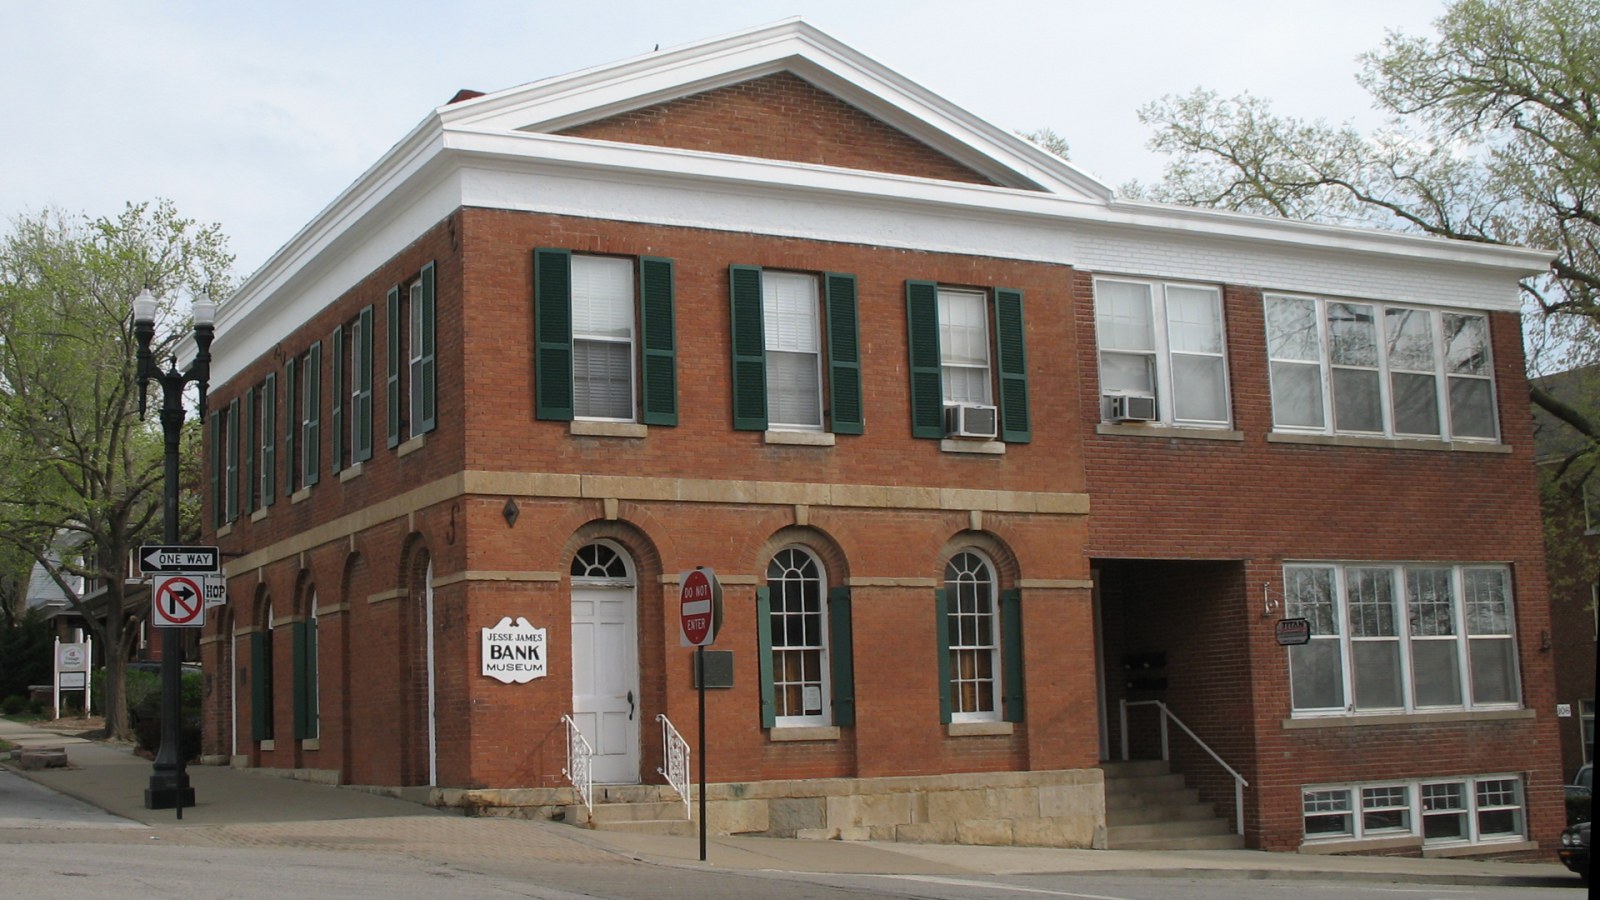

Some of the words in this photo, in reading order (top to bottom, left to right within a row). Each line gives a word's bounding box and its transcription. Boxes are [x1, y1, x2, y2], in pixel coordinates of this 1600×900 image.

[159, 554, 181, 564] ONE
[187, 554, 210, 564] WAY
[206, 585, 225, 598] HOP
[685, 587, 693, 598] DO
[696, 585, 707, 597] NOT
[687, 618, 705, 630] ENTER
[1282, 620, 1305, 629] TITAN
[487, 633, 514, 641] JESSE
[515, 634, 543, 642] JAMES
[490, 645, 540, 660] BANK
[486, 663, 543, 671] MUSEUM
